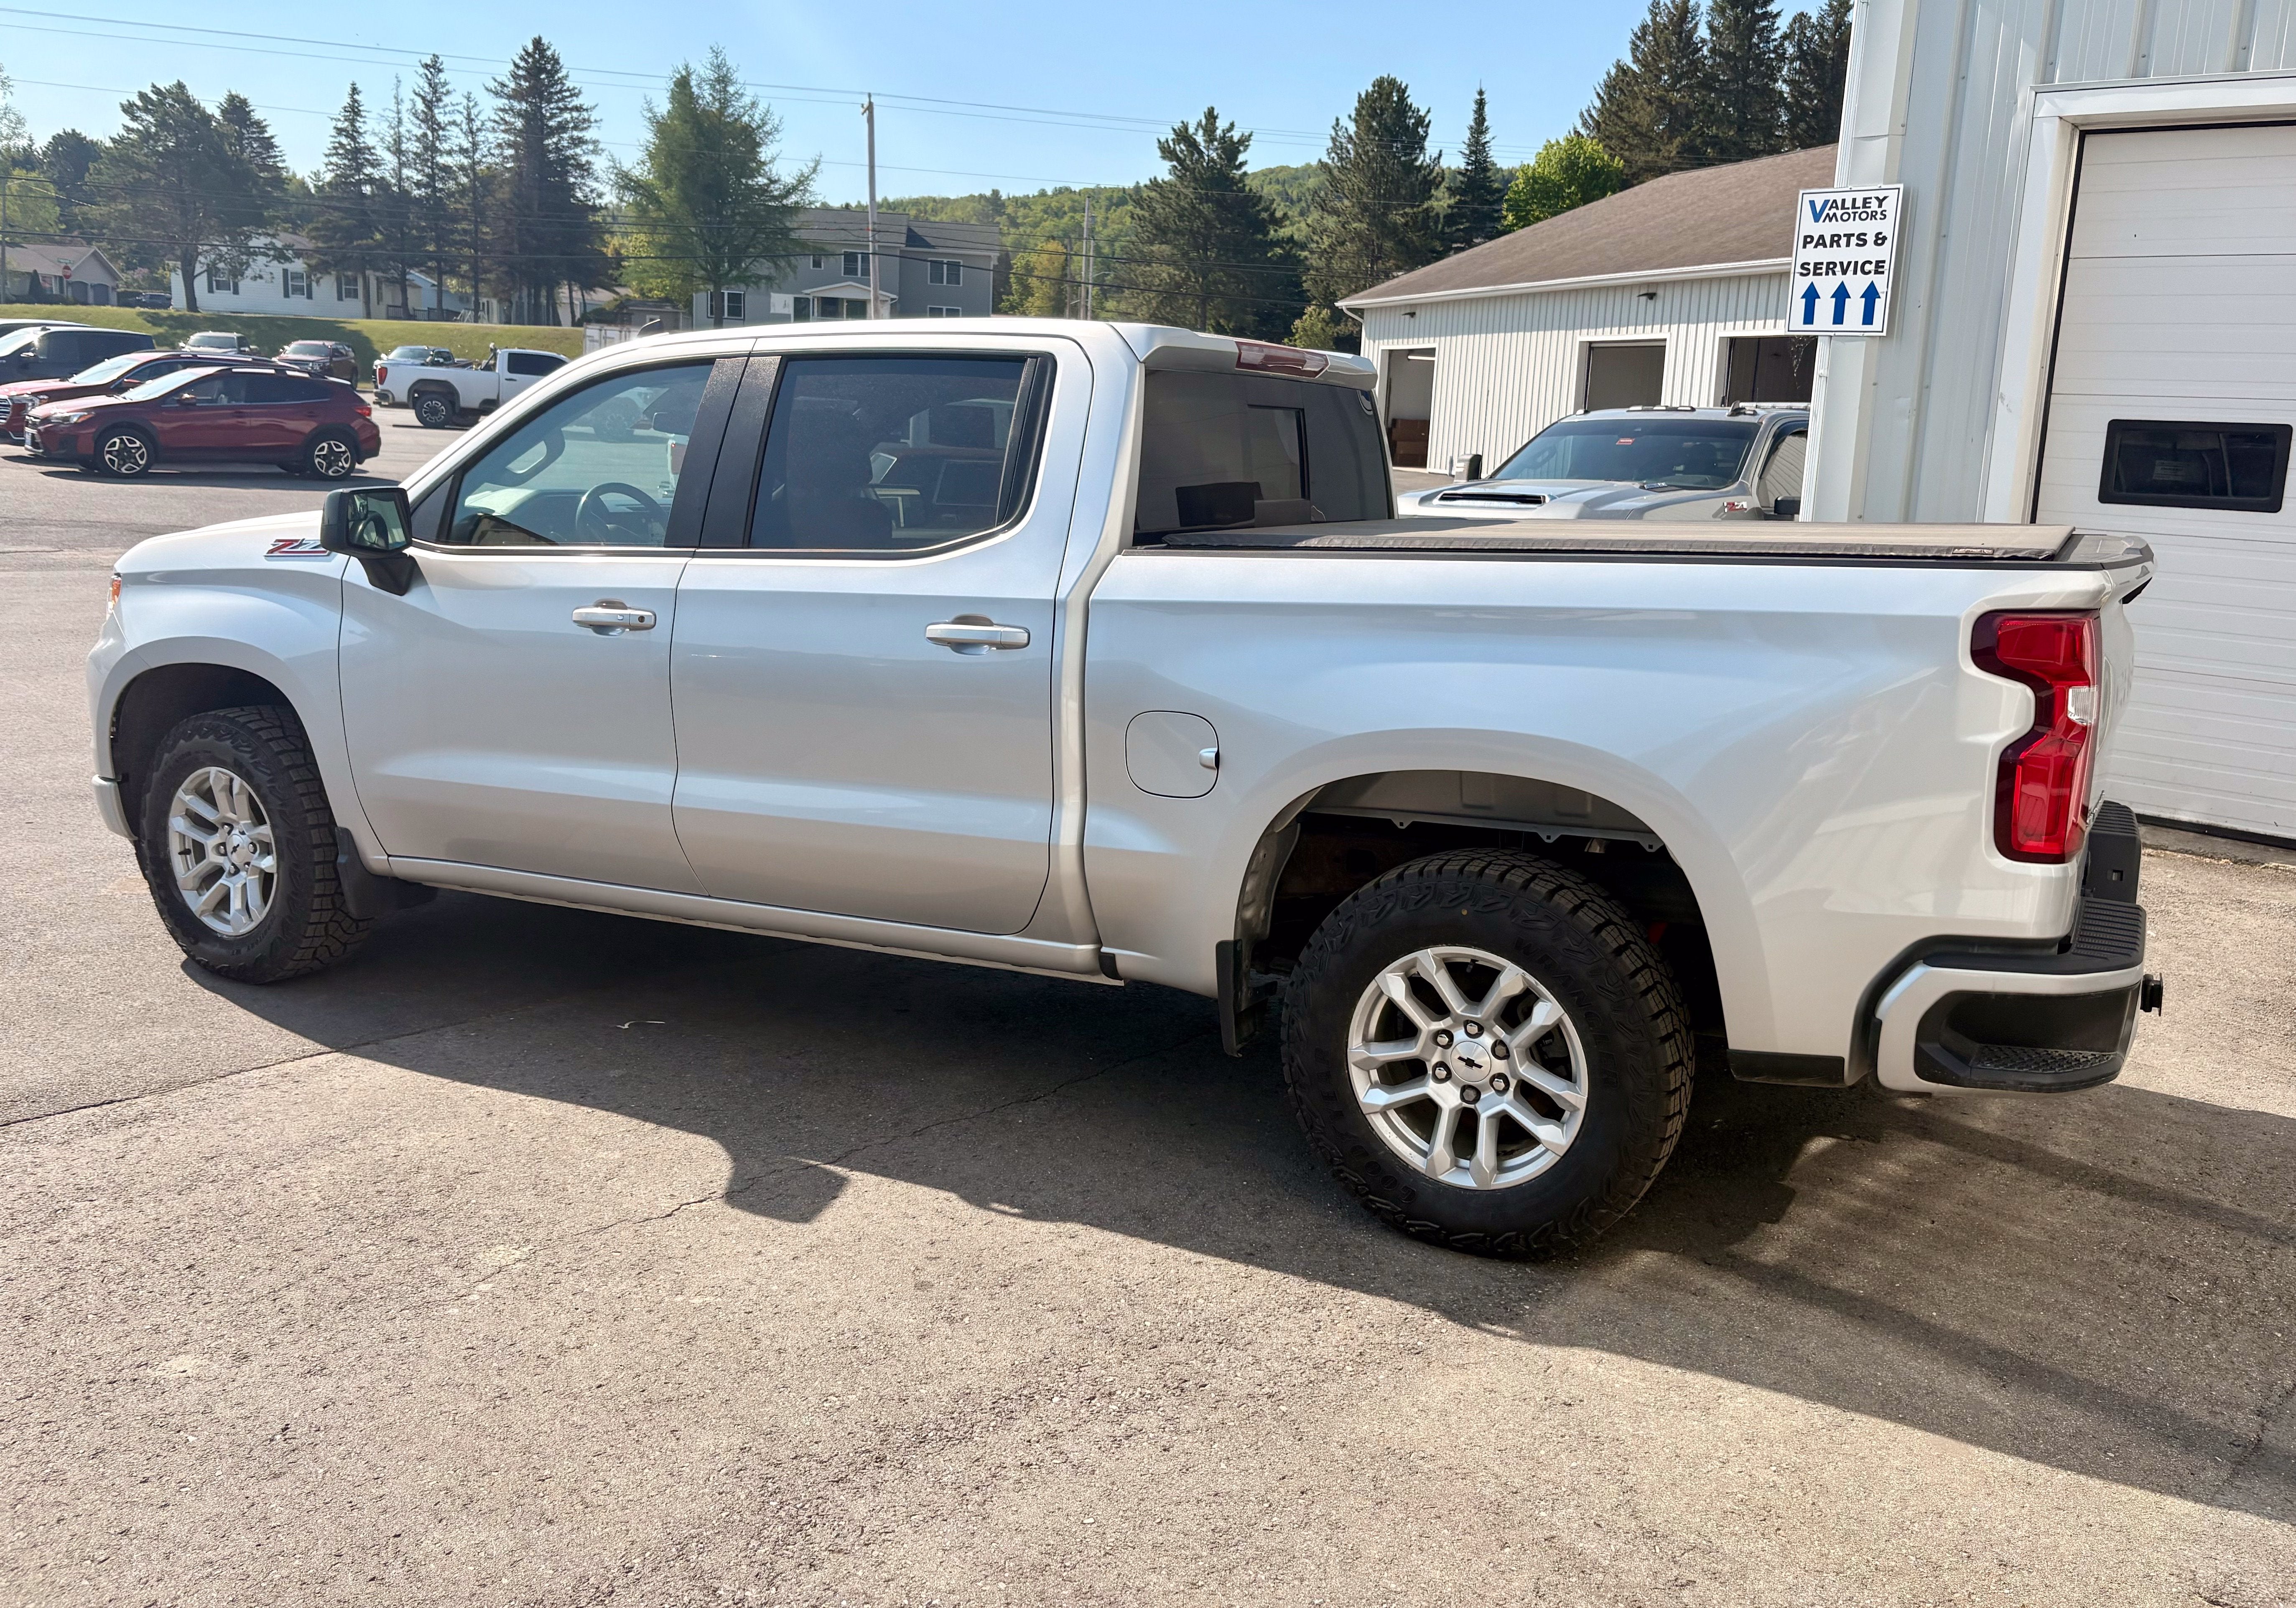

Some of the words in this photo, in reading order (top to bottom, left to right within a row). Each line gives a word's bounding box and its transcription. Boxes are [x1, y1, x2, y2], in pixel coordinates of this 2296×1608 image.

[1809, 196, 1889, 223] VALLEY
[1822, 209, 1887, 222] MOTORS
[1803, 233, 1867, 249] PARTS
[1873, 232, 1887, 246] &
[1799, 260, 1886, 276] SERVICE
[263, 538, 330, 557] Z7
[1513, 936, 1620, 1089] WRANGLER
